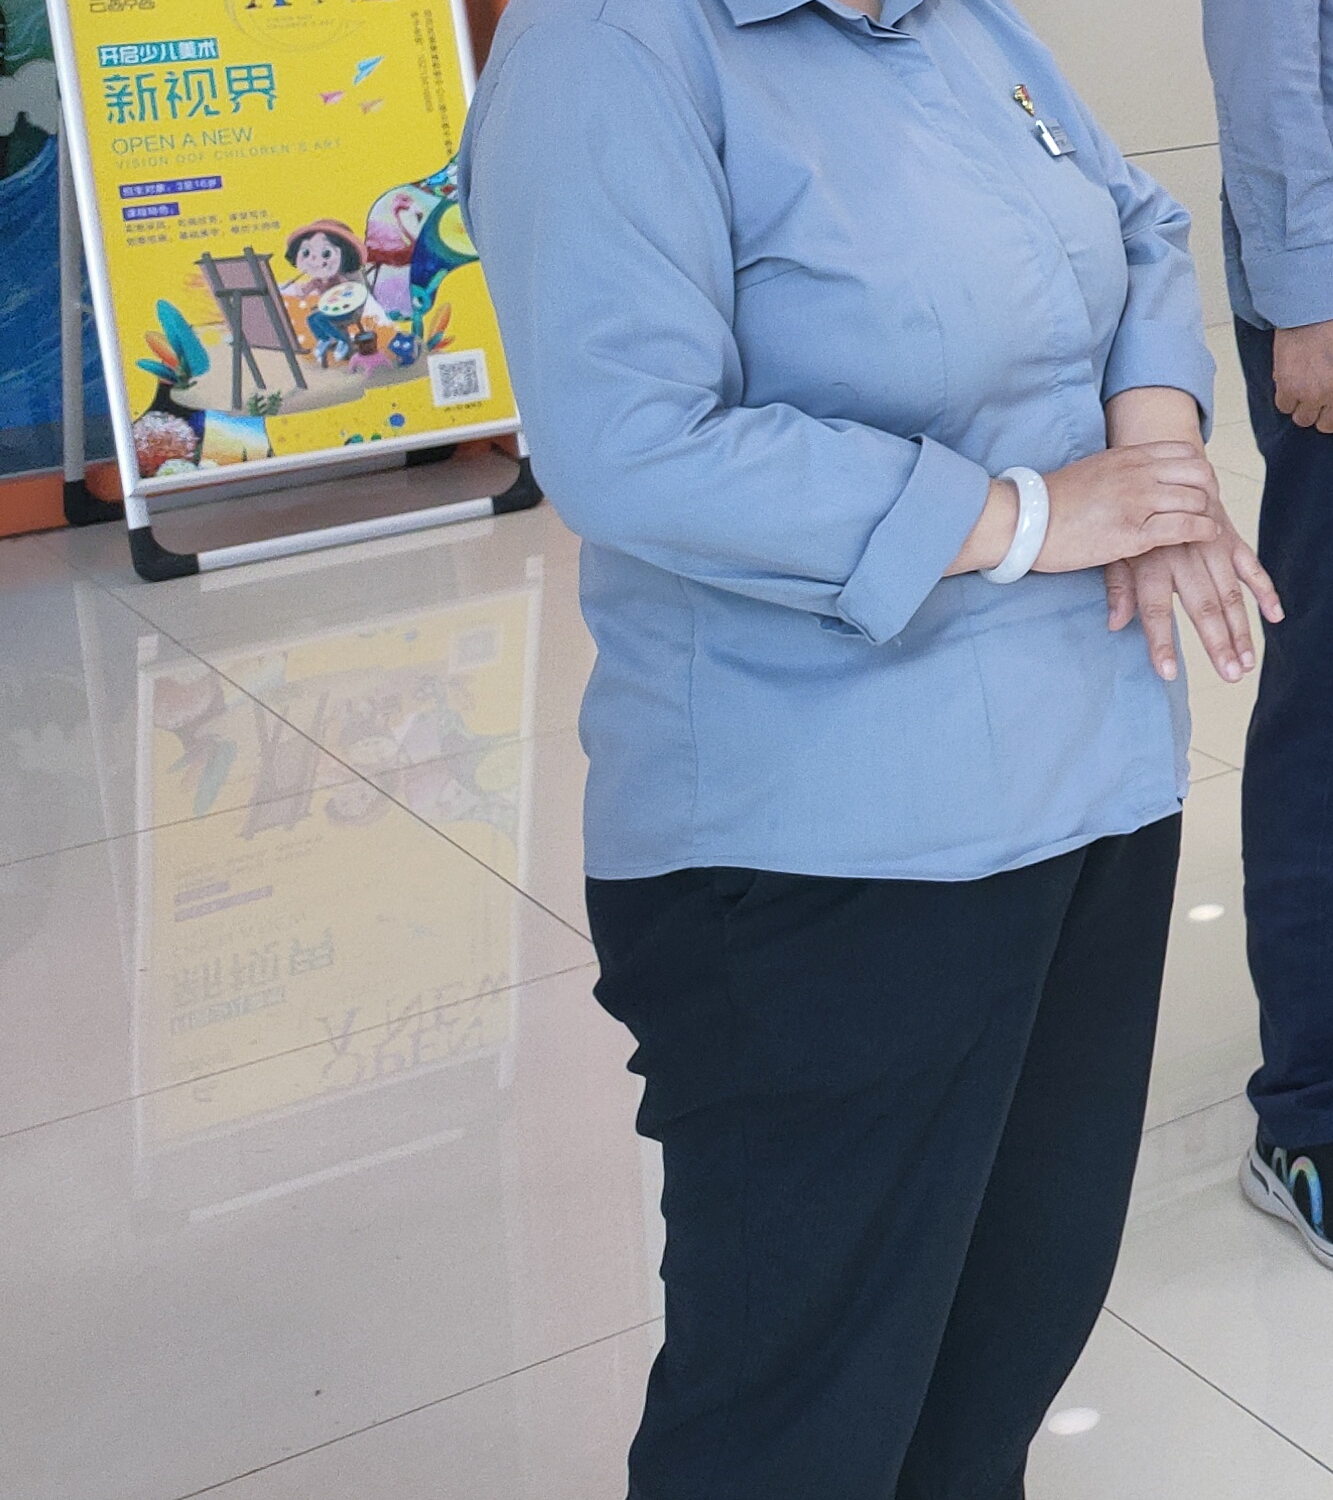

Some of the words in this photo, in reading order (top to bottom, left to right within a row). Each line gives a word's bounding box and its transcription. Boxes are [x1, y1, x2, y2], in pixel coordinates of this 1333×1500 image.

[100, 40, 217, 66] 开启少儿美术
[103, 62, 277, 125] 新视界
[111, 134, 176, 156] OPEN
[183, 131, 197, 148] A
[202, 126, 254, 147] NEW
[115, 156, 169, 170] VISION
